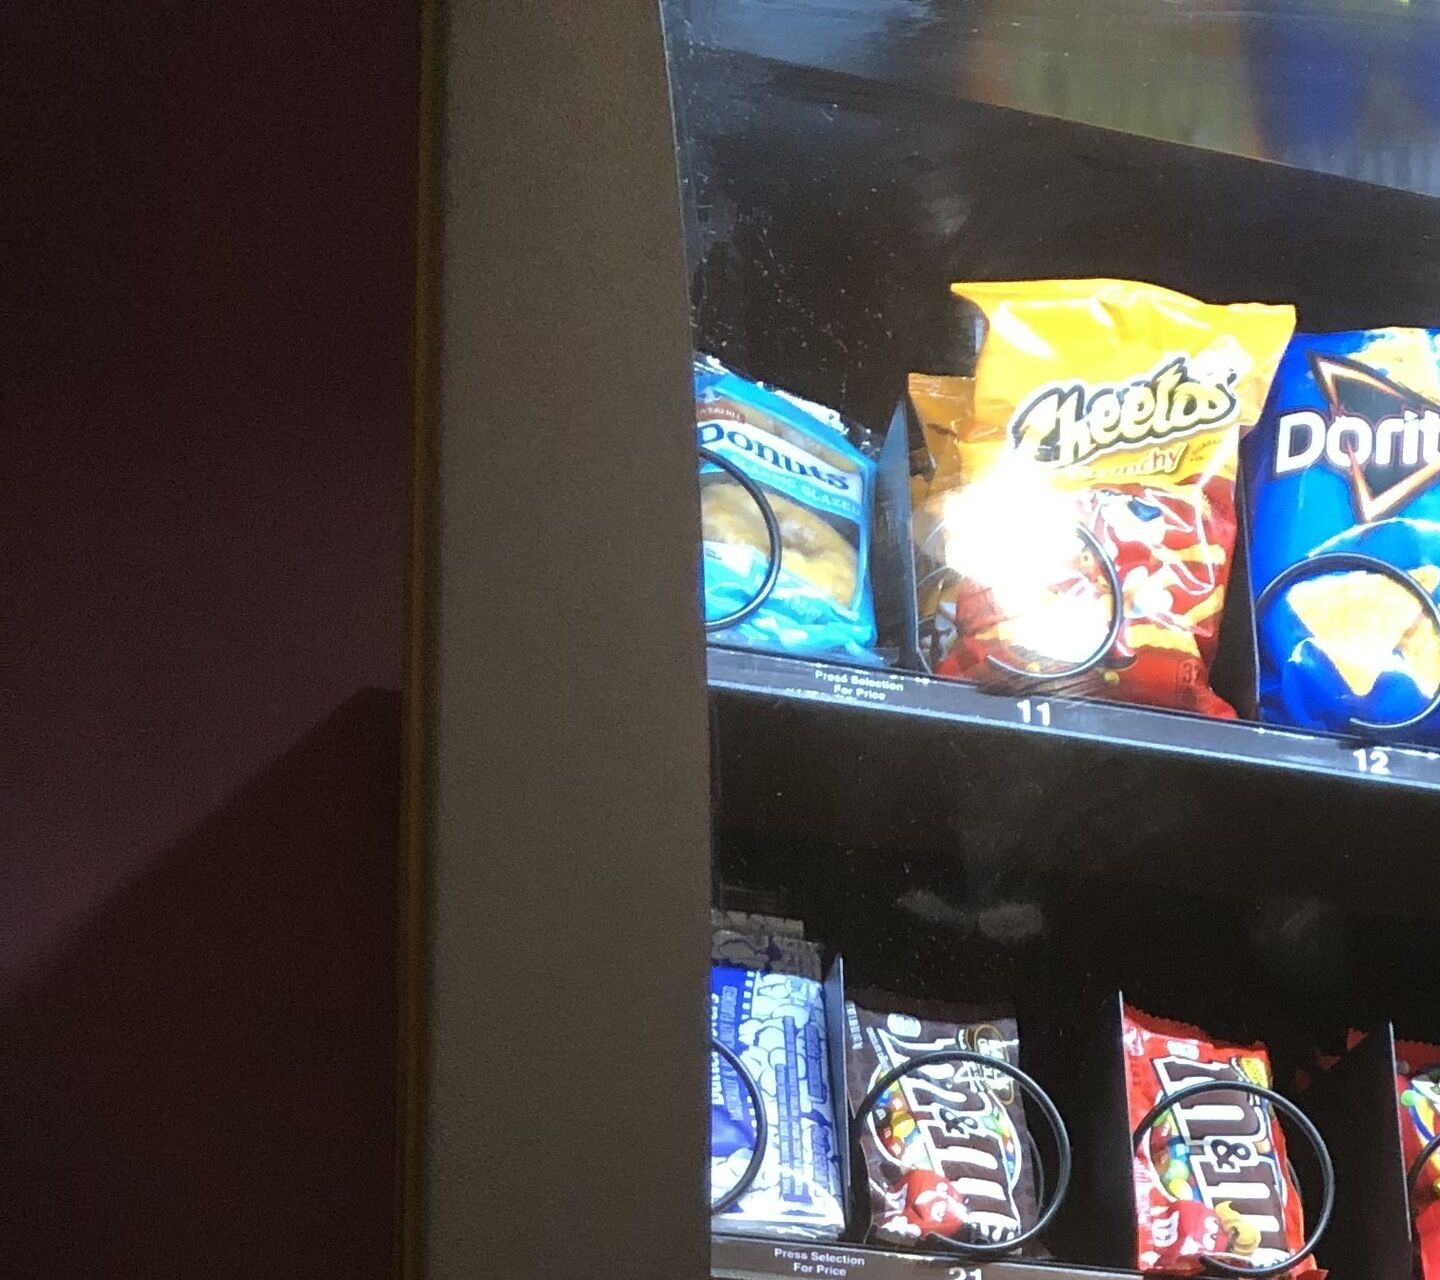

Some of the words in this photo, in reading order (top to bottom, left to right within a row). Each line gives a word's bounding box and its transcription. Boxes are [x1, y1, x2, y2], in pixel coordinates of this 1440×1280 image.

[1008, 357, 1238, 465] Cheetos
[699, 423, 850, 490] Donuts
[1016, 699, 1050, 726] 11
[1353, 749, 1390, 775] 12
[774, 1248, 807, 1262] Press
[810, 1251, 865, 1266] Selection
[793, 1263, 813, 1275] For
[816, 1265, 846, 1277] Price
